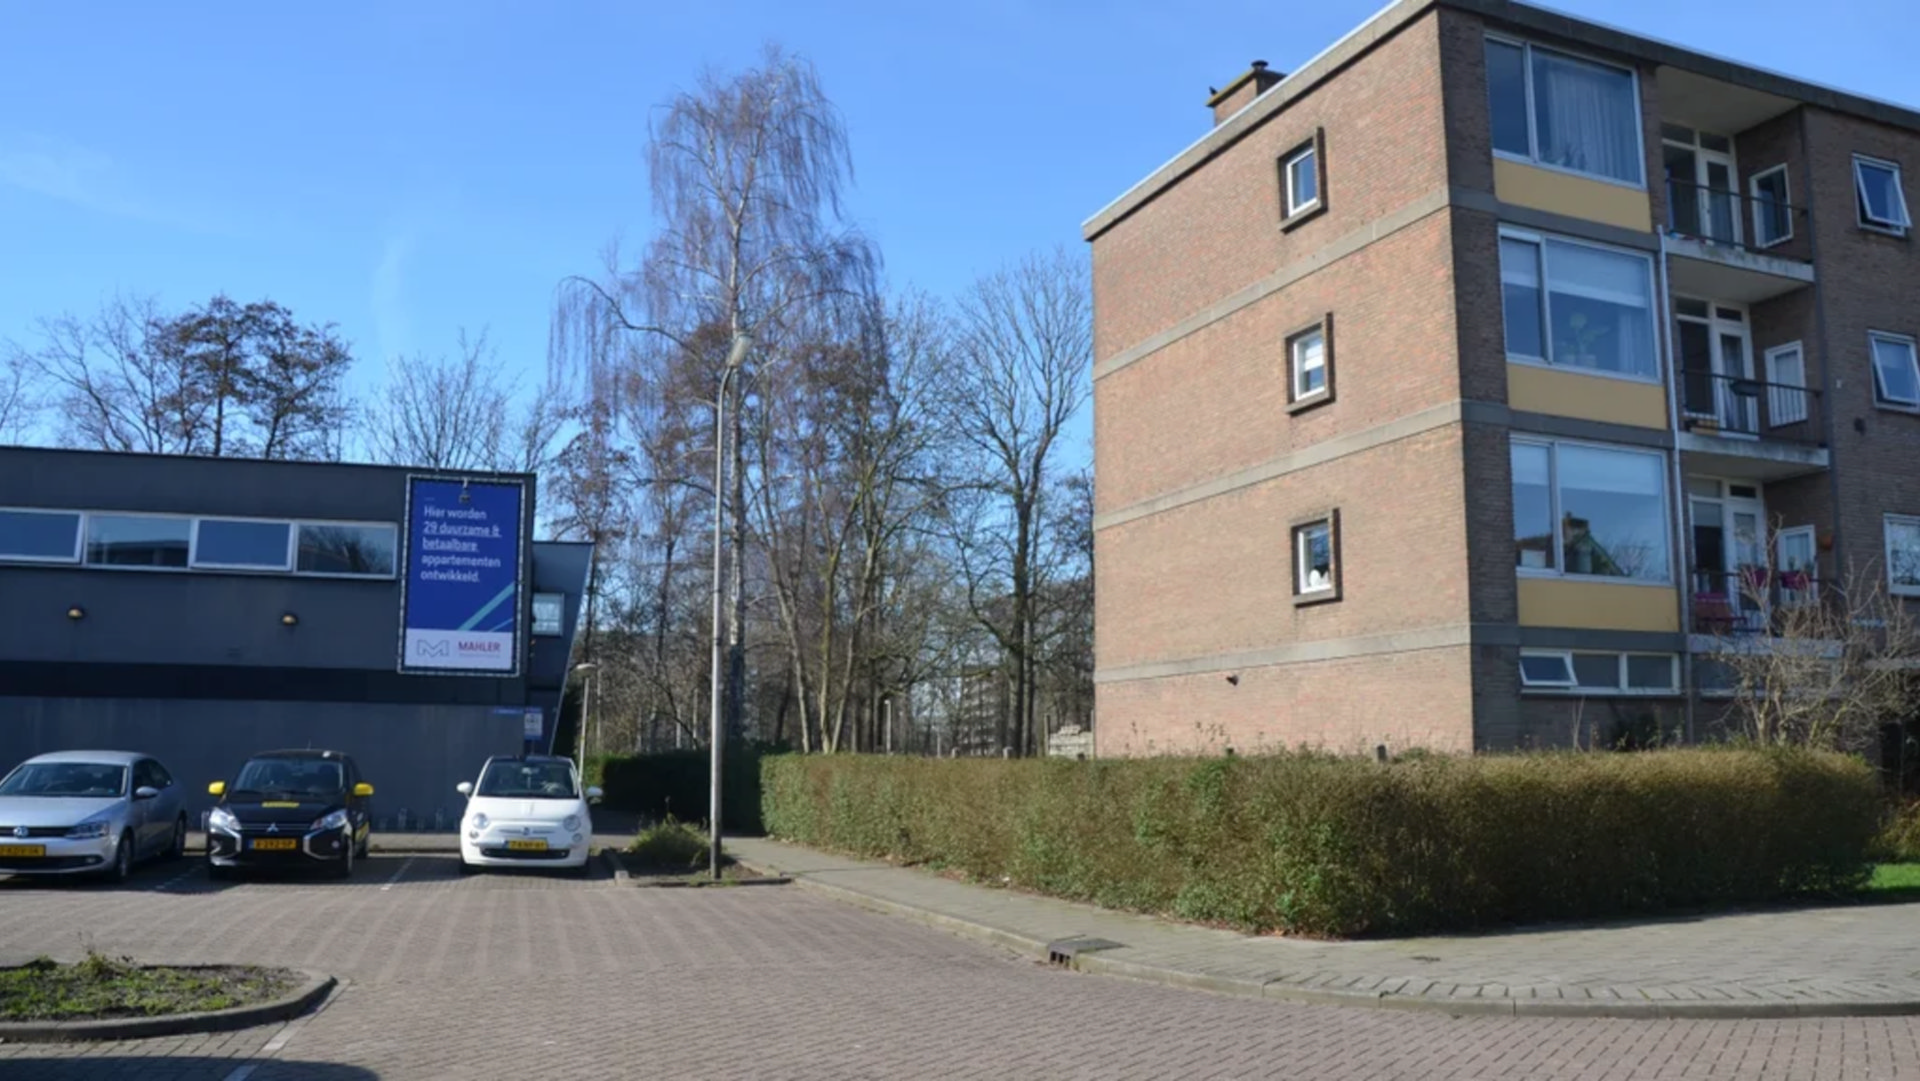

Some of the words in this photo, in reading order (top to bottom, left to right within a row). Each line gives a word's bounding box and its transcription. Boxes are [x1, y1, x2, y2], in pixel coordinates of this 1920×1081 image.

[424, 506, 446, 518] Hier
[447, 508, 487, 519] worden
[423, 521, 438, 533] 29
[440, 522, 490, 536] duurzame
[422, 537, 477, 551] betaalbare
[421, 555, 501, 568] appartementen
[420, 570, 479, 583] ontwikkeld.
[458, 641, 501, 652] MAHLER
